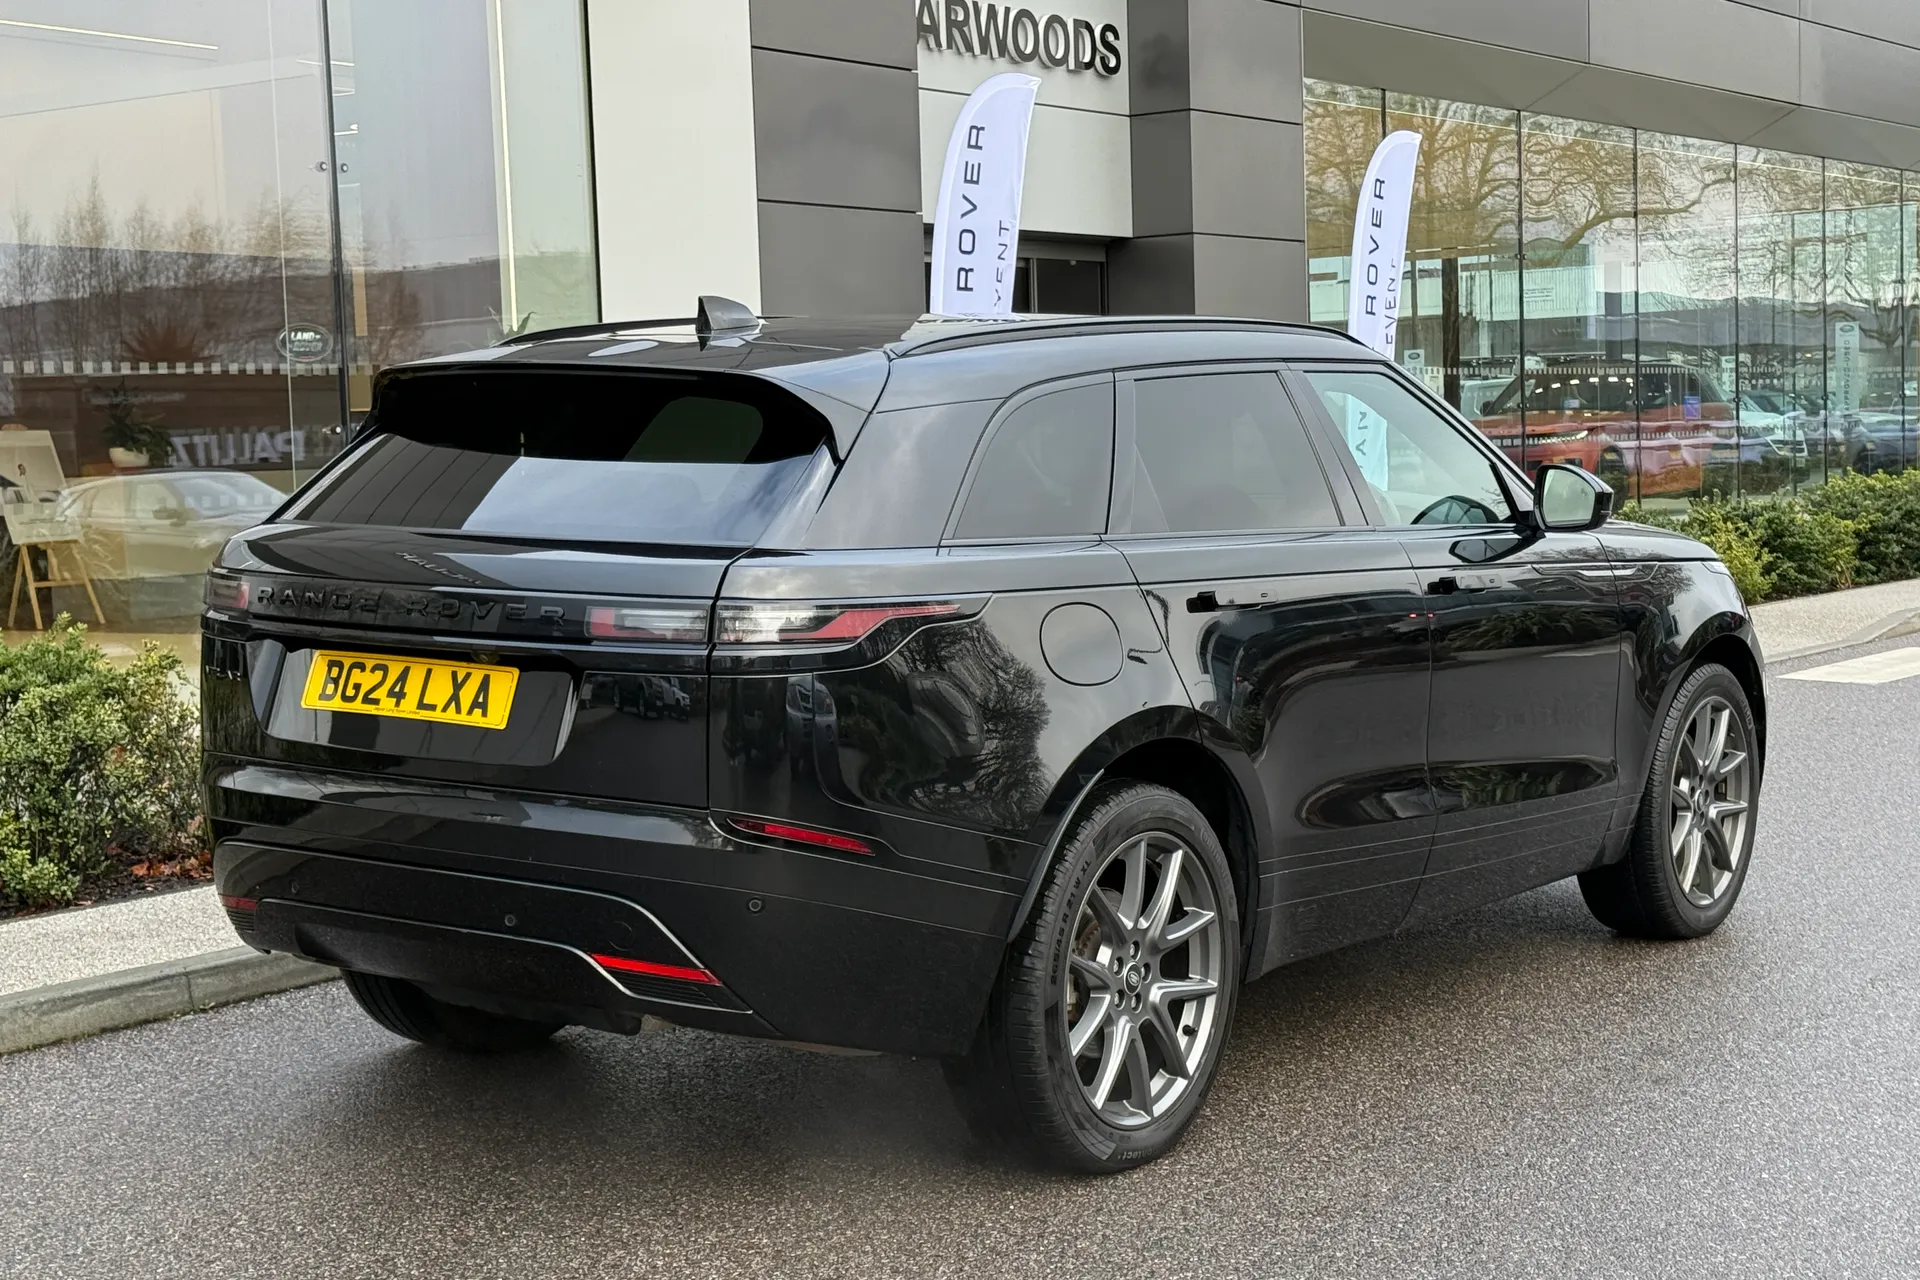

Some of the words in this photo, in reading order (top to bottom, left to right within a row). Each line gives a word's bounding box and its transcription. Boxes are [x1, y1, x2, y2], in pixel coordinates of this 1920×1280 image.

[956, 124, 986, 292] ROVER
[993, 219, 1010, 308] VENT
[1365, 178, 1386, 316] ROVER
[257, 586, 382, 613] RANGE
[406, 597, 566, 626] ROVER
[318, 659, 410, 708] BG24
[416, 667, 491, 718] LXA
[1066, 893, 1076, 908] 21
[1080, 860, 1092, 876] XL
